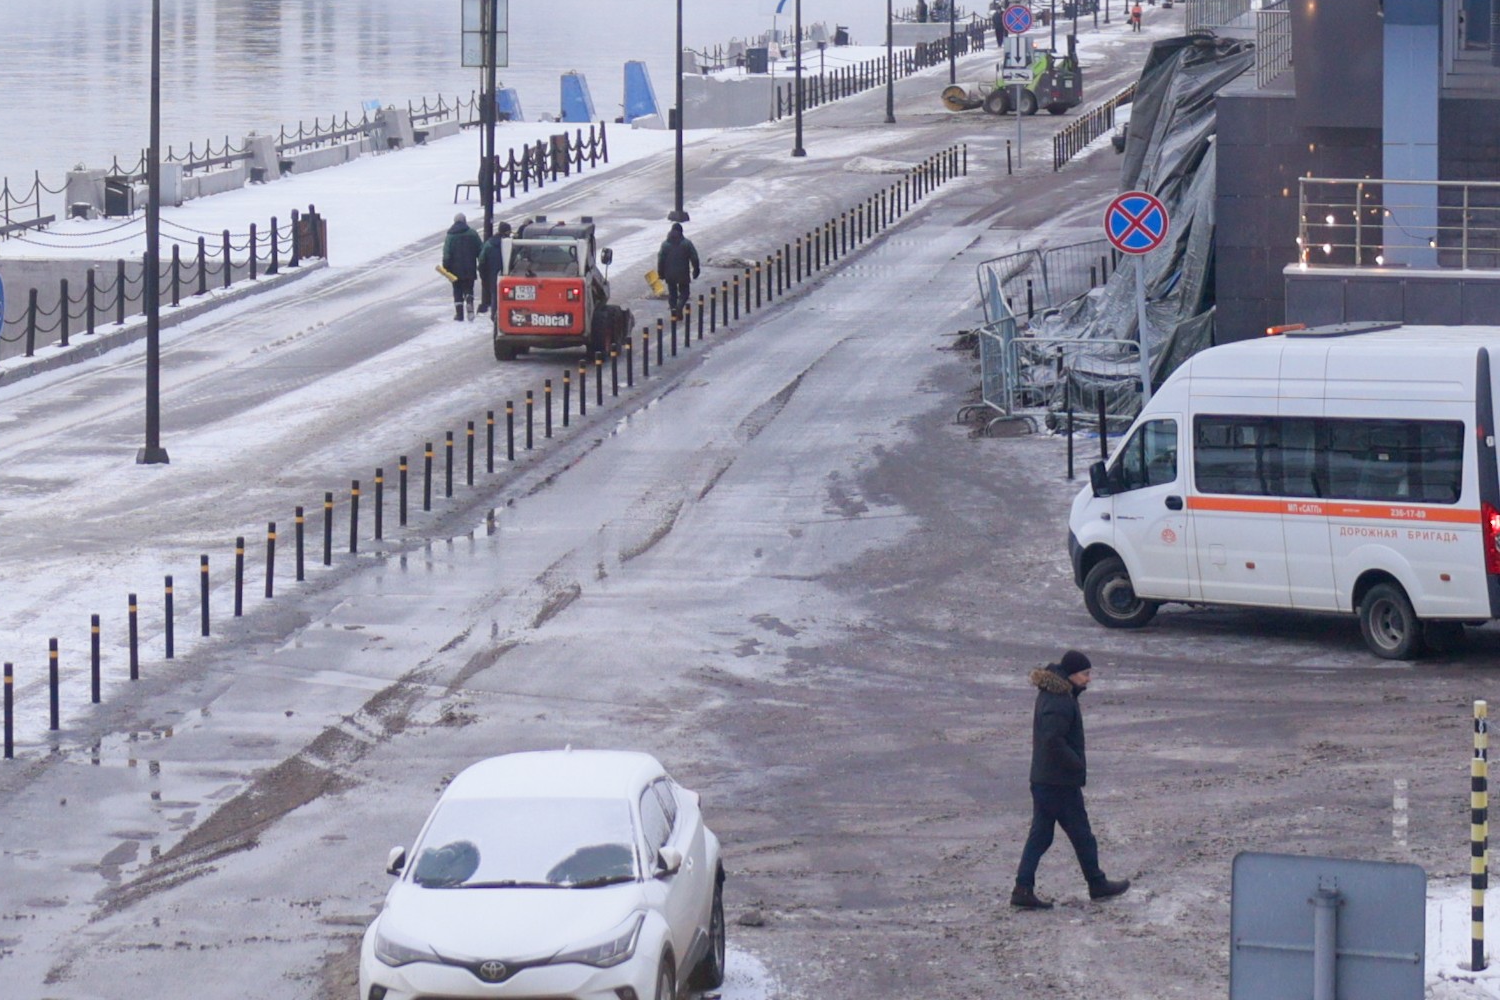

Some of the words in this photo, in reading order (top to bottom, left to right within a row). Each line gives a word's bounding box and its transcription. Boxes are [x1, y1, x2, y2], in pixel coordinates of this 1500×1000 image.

[531, 313, 569, 326] Bobcat
[1340, 526, 1398, 538] ДОРОЖНАЯ
[1408, 530, 1458, 543] БРИГАДА
